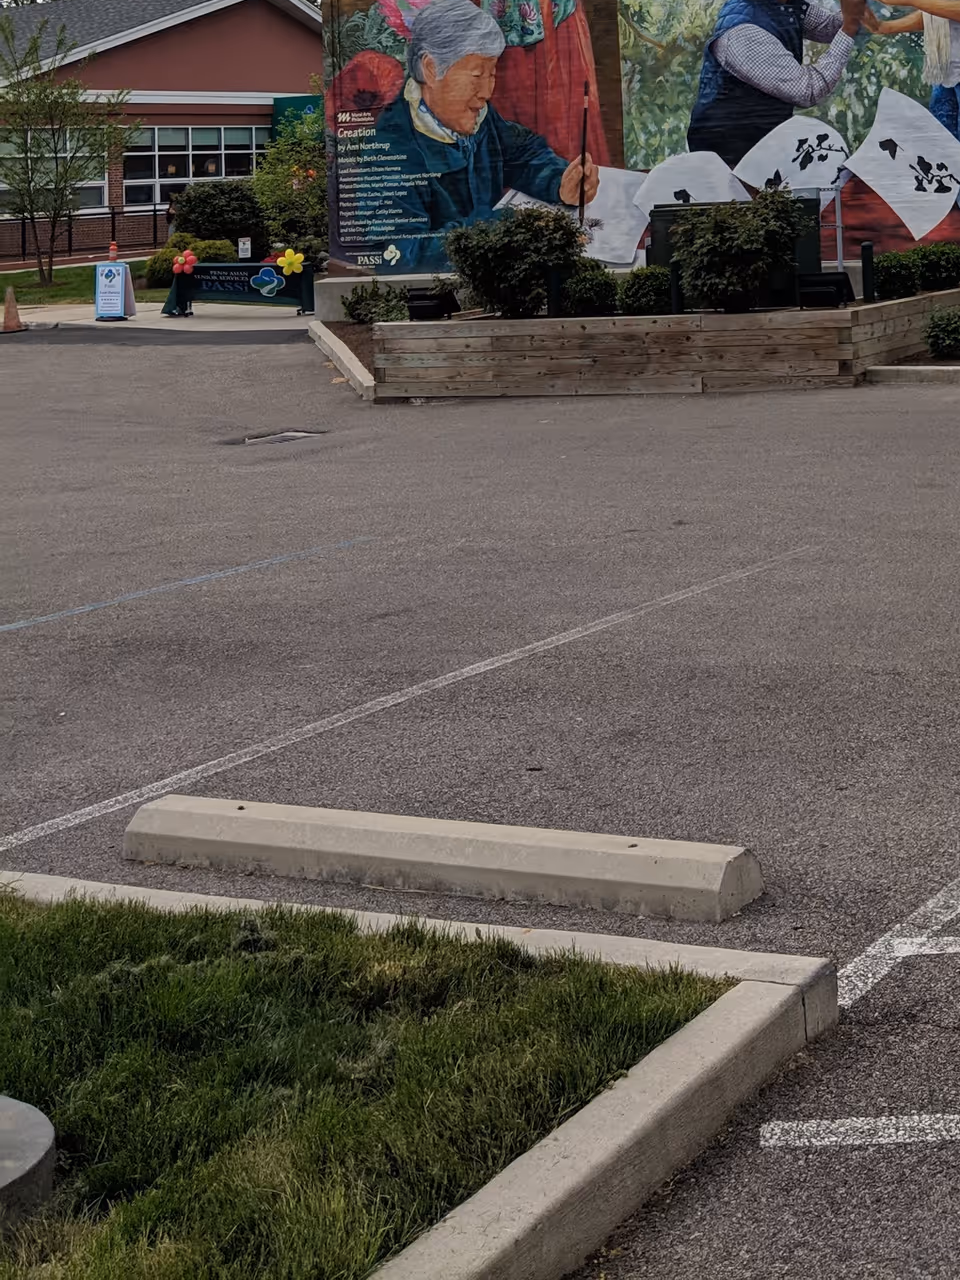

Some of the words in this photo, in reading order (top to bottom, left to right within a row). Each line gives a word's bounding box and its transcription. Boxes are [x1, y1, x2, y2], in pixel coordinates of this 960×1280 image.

[337, 127, 376, 138] Creation
[337, 143, 346, 152] by
[360, 141, 390, 151] Northrup
[357, 256, 382, 265] PASSi
[201, 281, 248, 293] PASSi
